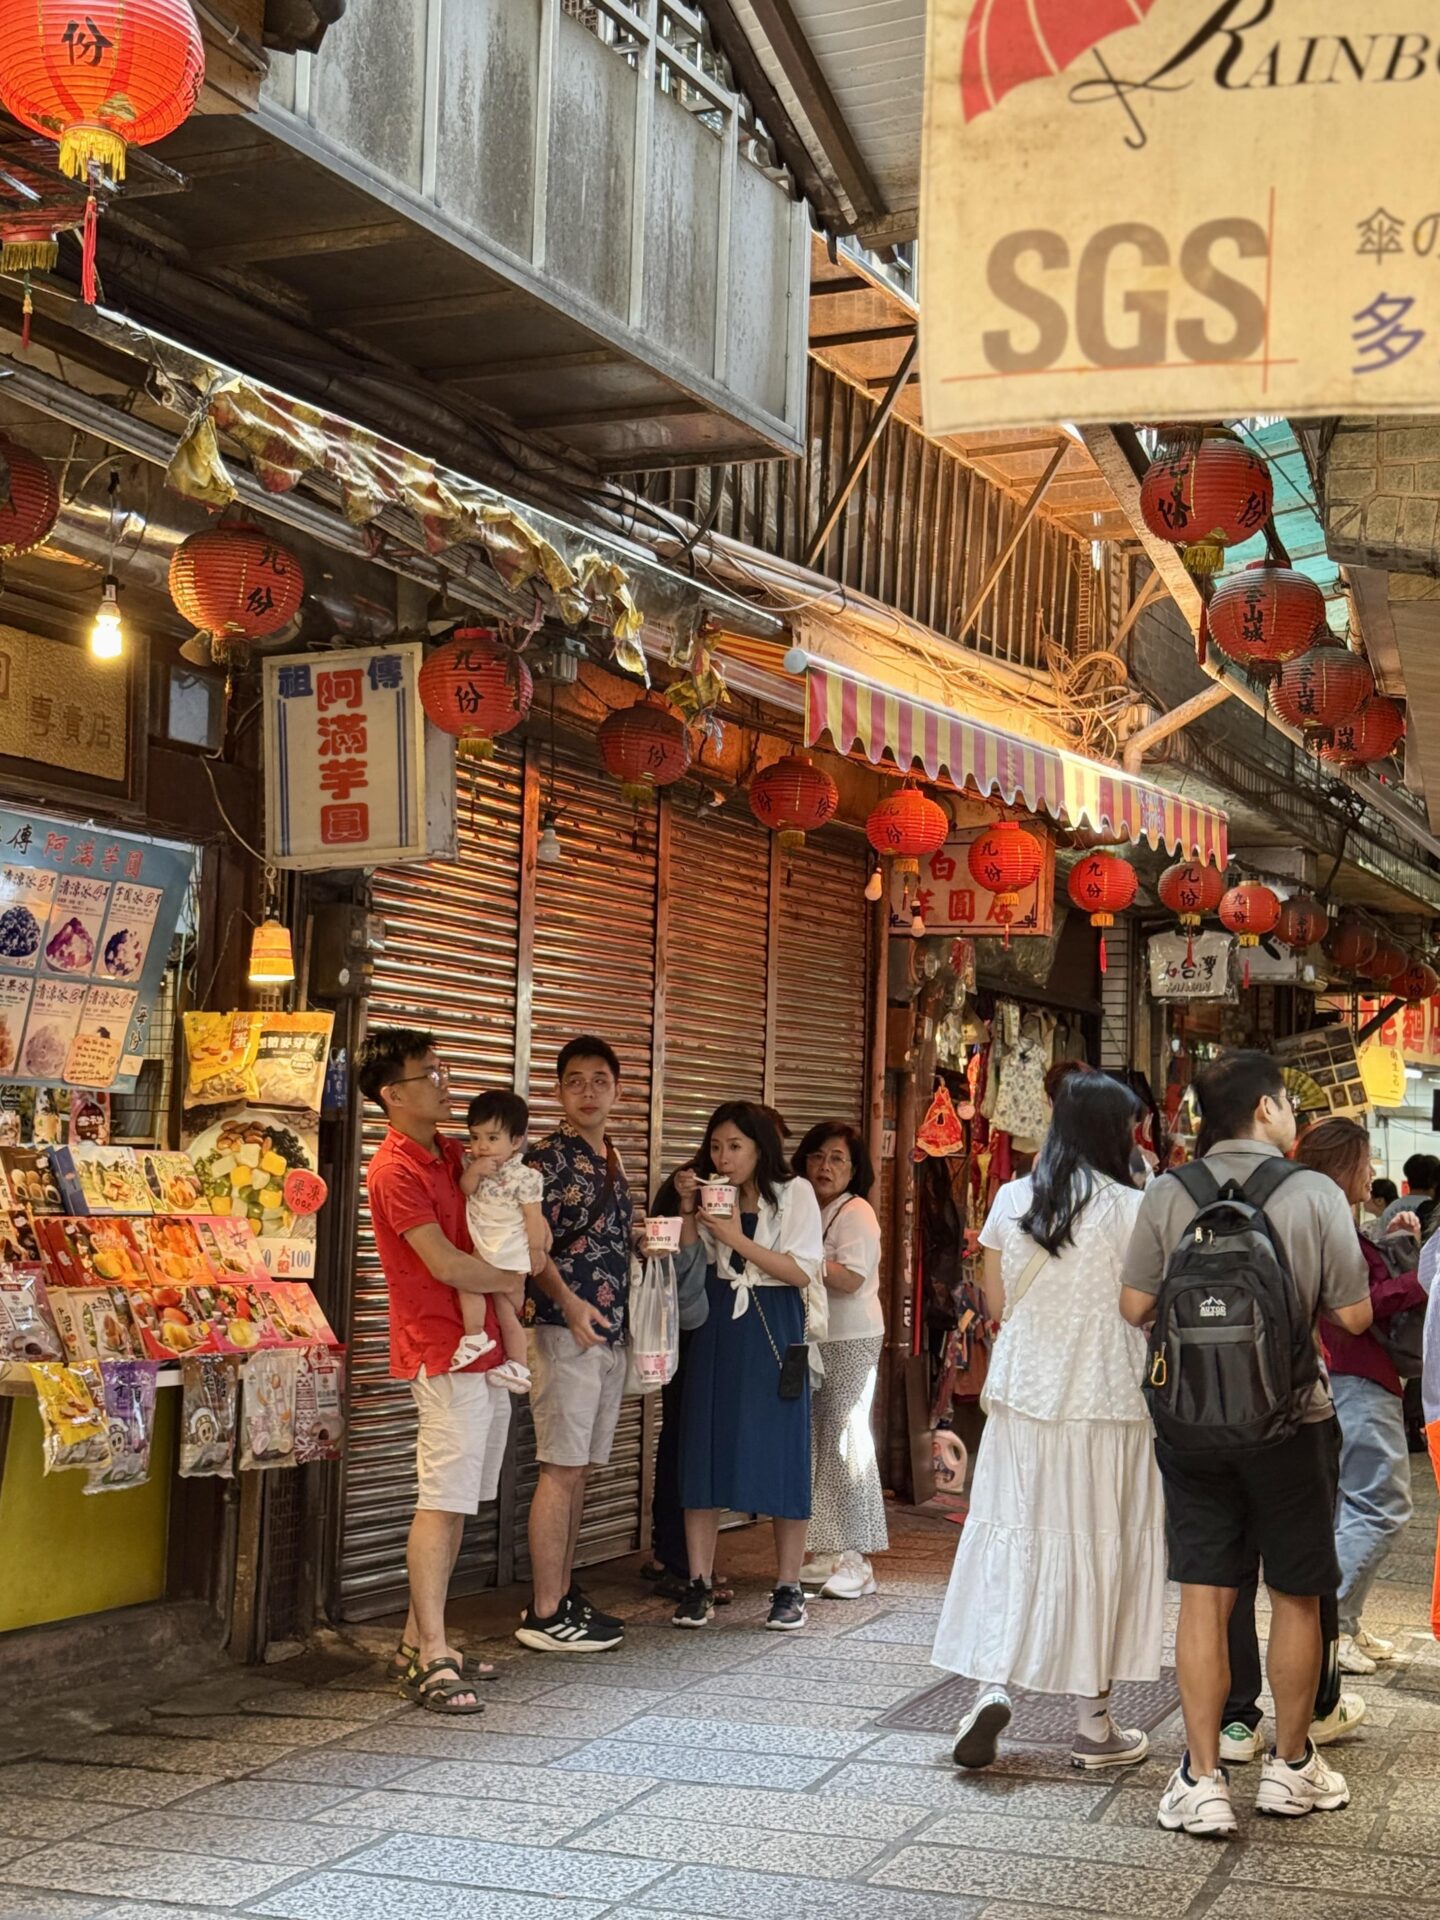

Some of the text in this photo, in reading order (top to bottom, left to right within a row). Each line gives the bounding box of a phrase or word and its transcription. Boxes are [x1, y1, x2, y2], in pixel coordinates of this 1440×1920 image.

[61, 15, 115, 67] 份
[1068, 0, 1440, 104] RAINB
[981, 217, 1269, 374] SGS
[245, 545, 288, 617] 九份
[278, 654, 403, 699] 祖 傳
[451, 648, 484, 715] 九份
[316, 668, 370, 845] 阿滿芋圓
[0, 823, 33, 856] 傳
[980, 839, 1003, 883] 九份
[1087, 861, 1104, 899] 九份
[1179, 868, 1200, 907] 九份
[1233, 893, 1248, 924] 九份
[290, 1249, 311, 1268] 100
